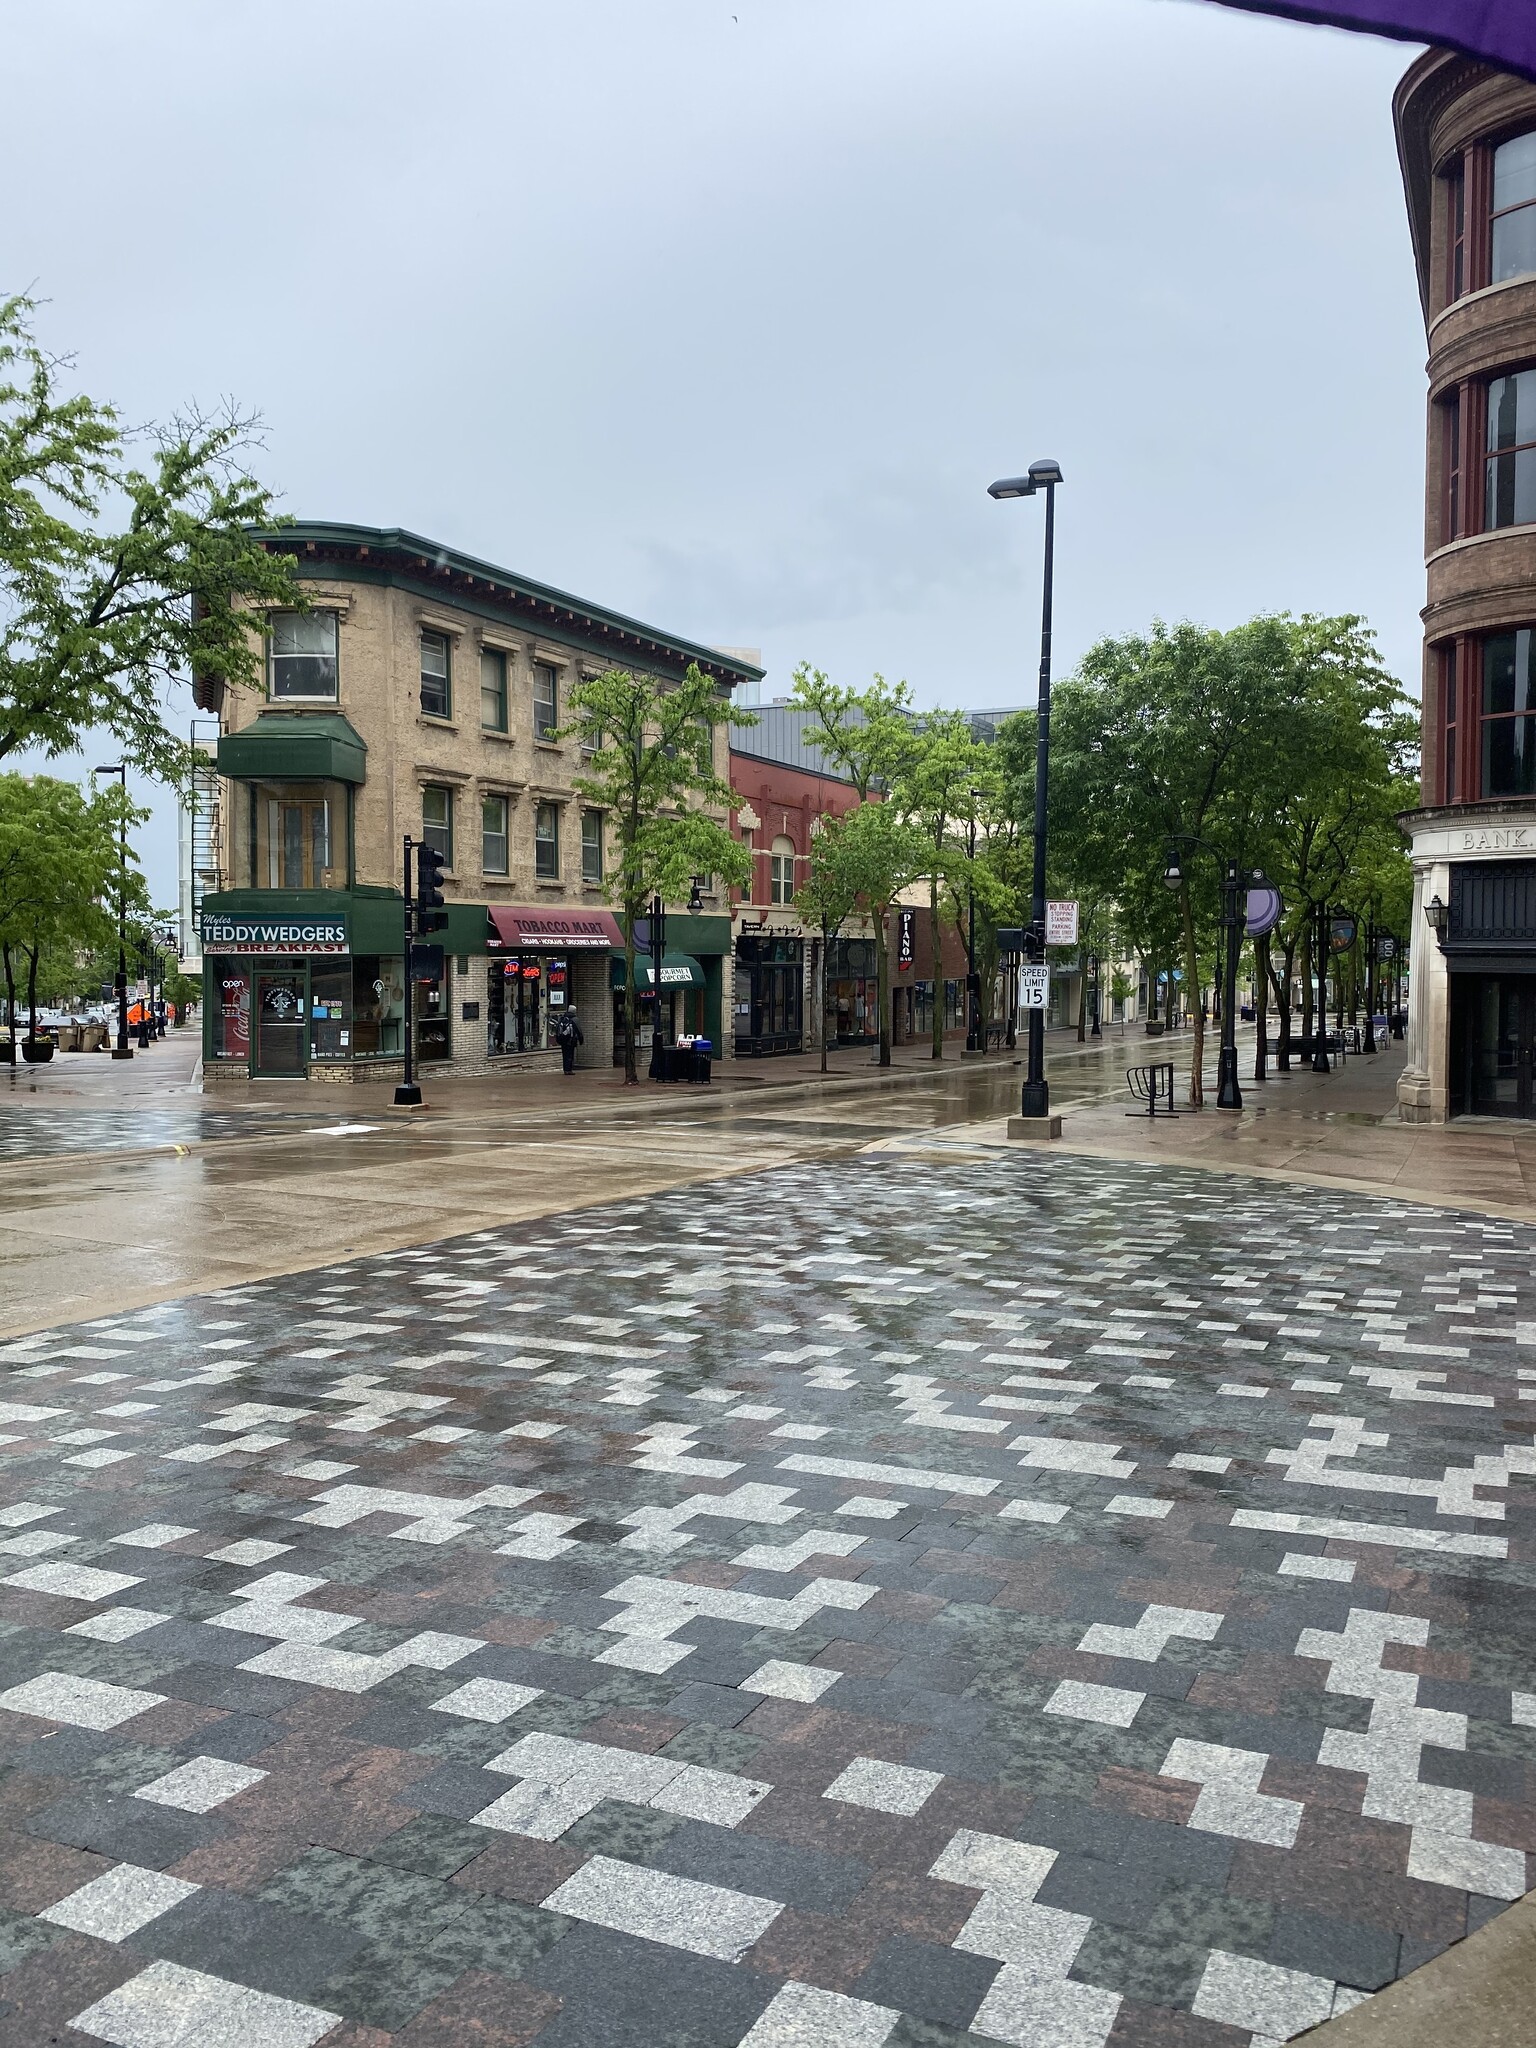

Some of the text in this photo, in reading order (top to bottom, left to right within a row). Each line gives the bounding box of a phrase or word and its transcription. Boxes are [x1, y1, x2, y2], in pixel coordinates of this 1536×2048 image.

[203, 914, 232, 926] Myles
[514, 920, 605, 933] TOBACCO MART
[902, 914, 911, 956] PIANO
[236, 944, 346, 952] BREAKFAST
[1385, 938, 1394, 957] 100
[504, 964, 519, 972] ATM
[1021, 968, 1047, 977] SPEED
[222, 980, 244, 989] open
[1024, 979, 1045, 987] LIMIT
[1026, 988, 1043, 1004] 15
